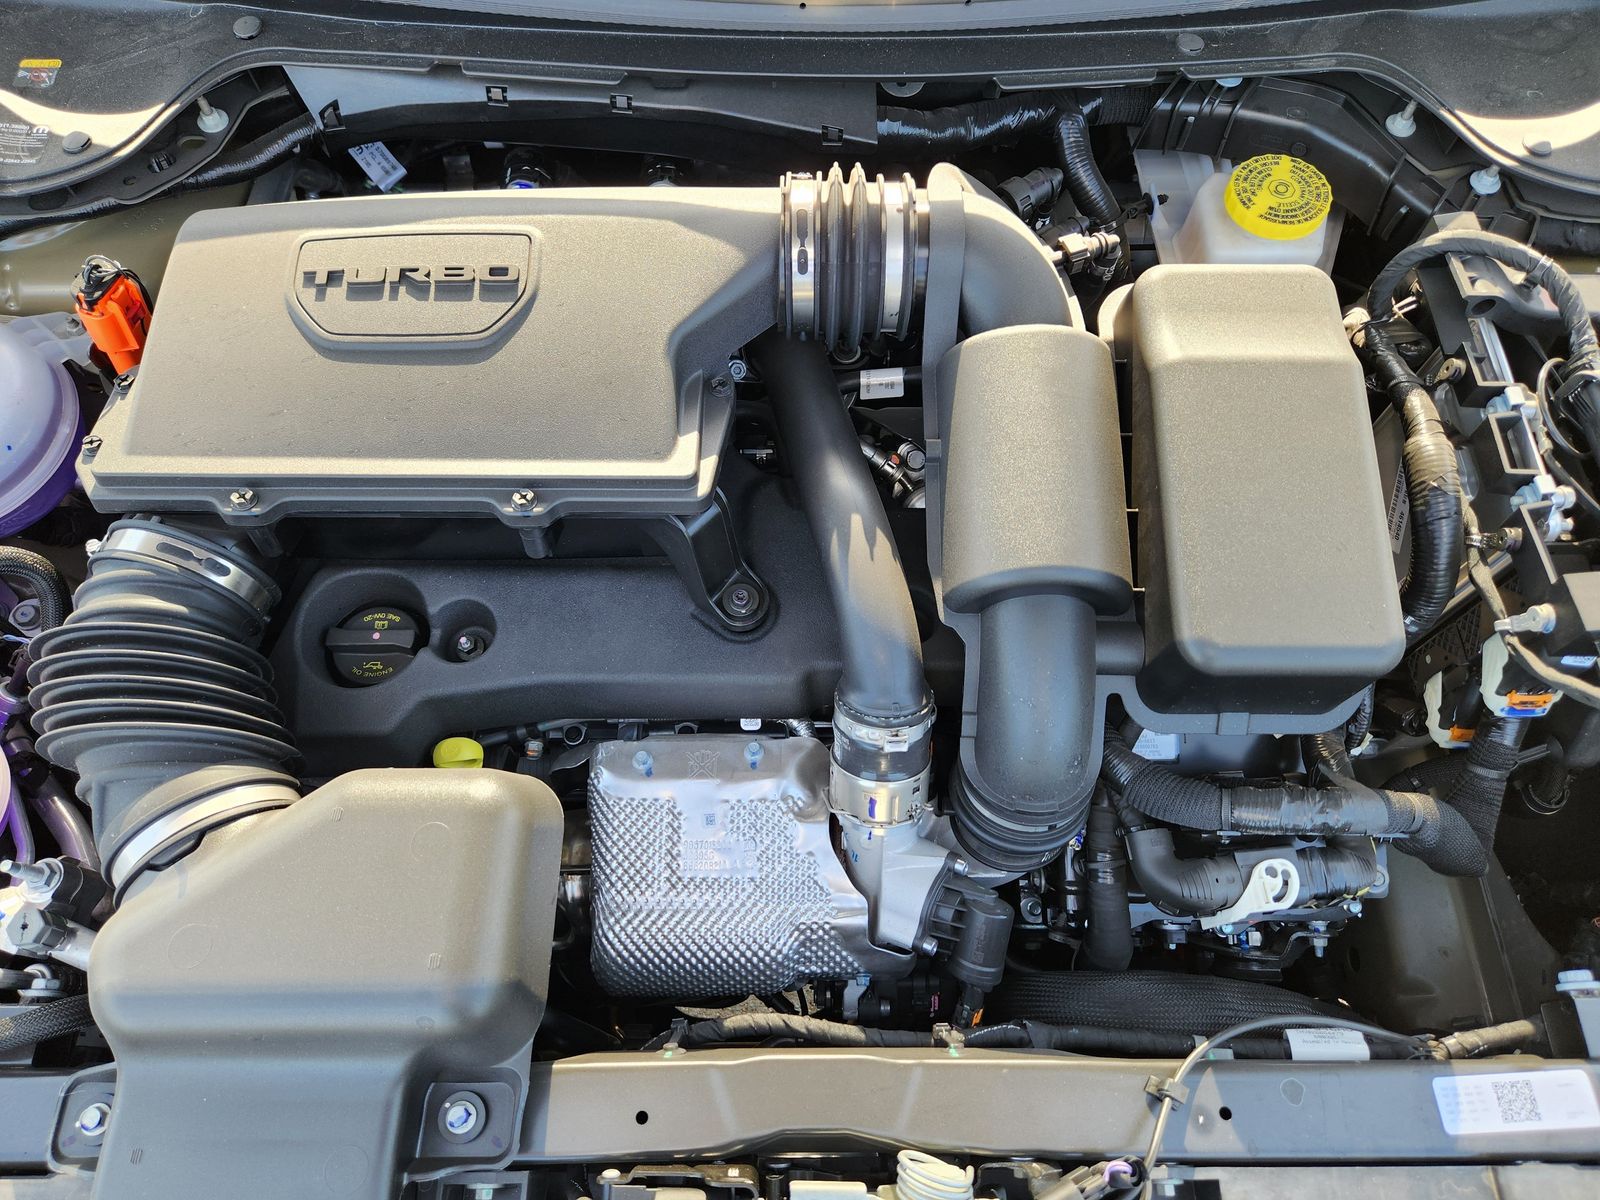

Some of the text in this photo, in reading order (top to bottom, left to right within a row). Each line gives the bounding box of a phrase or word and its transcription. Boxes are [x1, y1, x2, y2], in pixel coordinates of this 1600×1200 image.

[1256, 167, 1272, 175] CLEAN
[1292, 164, 1308, 174] AVANT
[1291, 175, 1305, 201] CONTENANT
[302, 264, 521, 293] TURBO
[387, 612, 401, 622] SAE
[351, 666, 393, 677] ENGINE OIL
